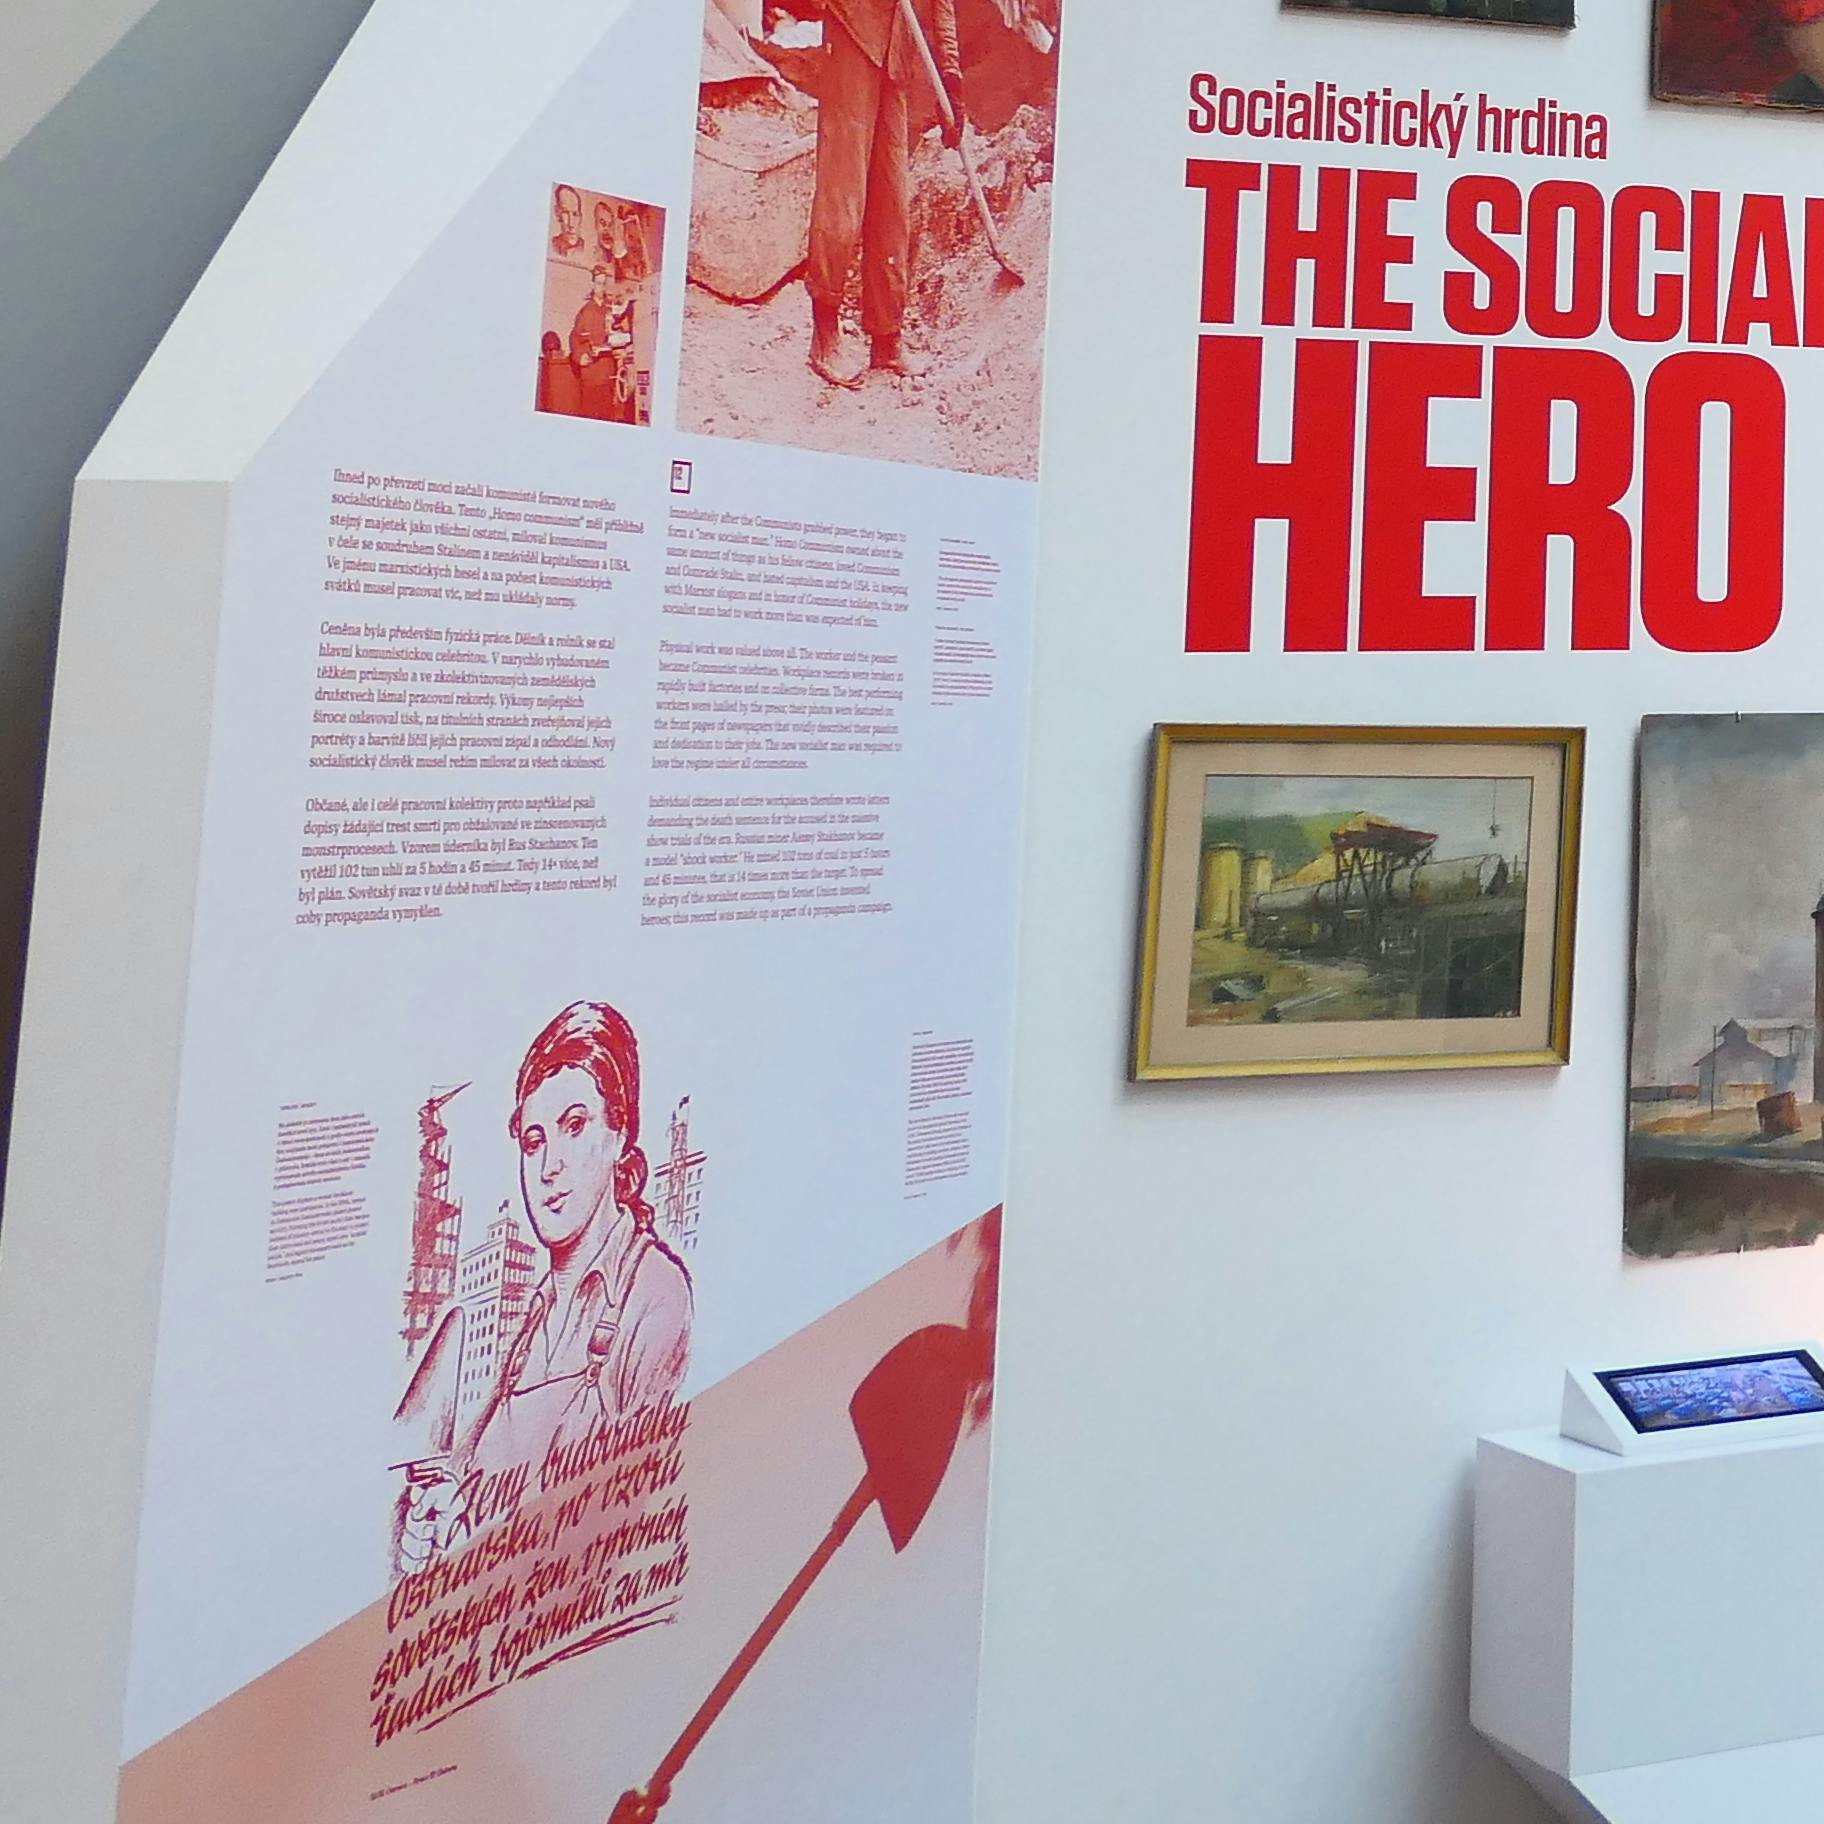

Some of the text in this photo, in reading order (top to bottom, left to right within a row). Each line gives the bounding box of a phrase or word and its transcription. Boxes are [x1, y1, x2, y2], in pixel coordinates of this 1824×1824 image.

[1186, 71, 1608, 159] Socialistický hrdina
[1184, 158, 1418, 331] THE
[1183, 335, 1786, 653] HERO
[539, 1392, 692, 1493] budovatelky
[551, 1483, 595, 1551] po
[602, 1451, 684, 1512] vzoru
[370, 1574, 517, 1702] sovětských
[489, 1568, 612, 1685] bojovníků
[611, 1580, 642, 1616] za
